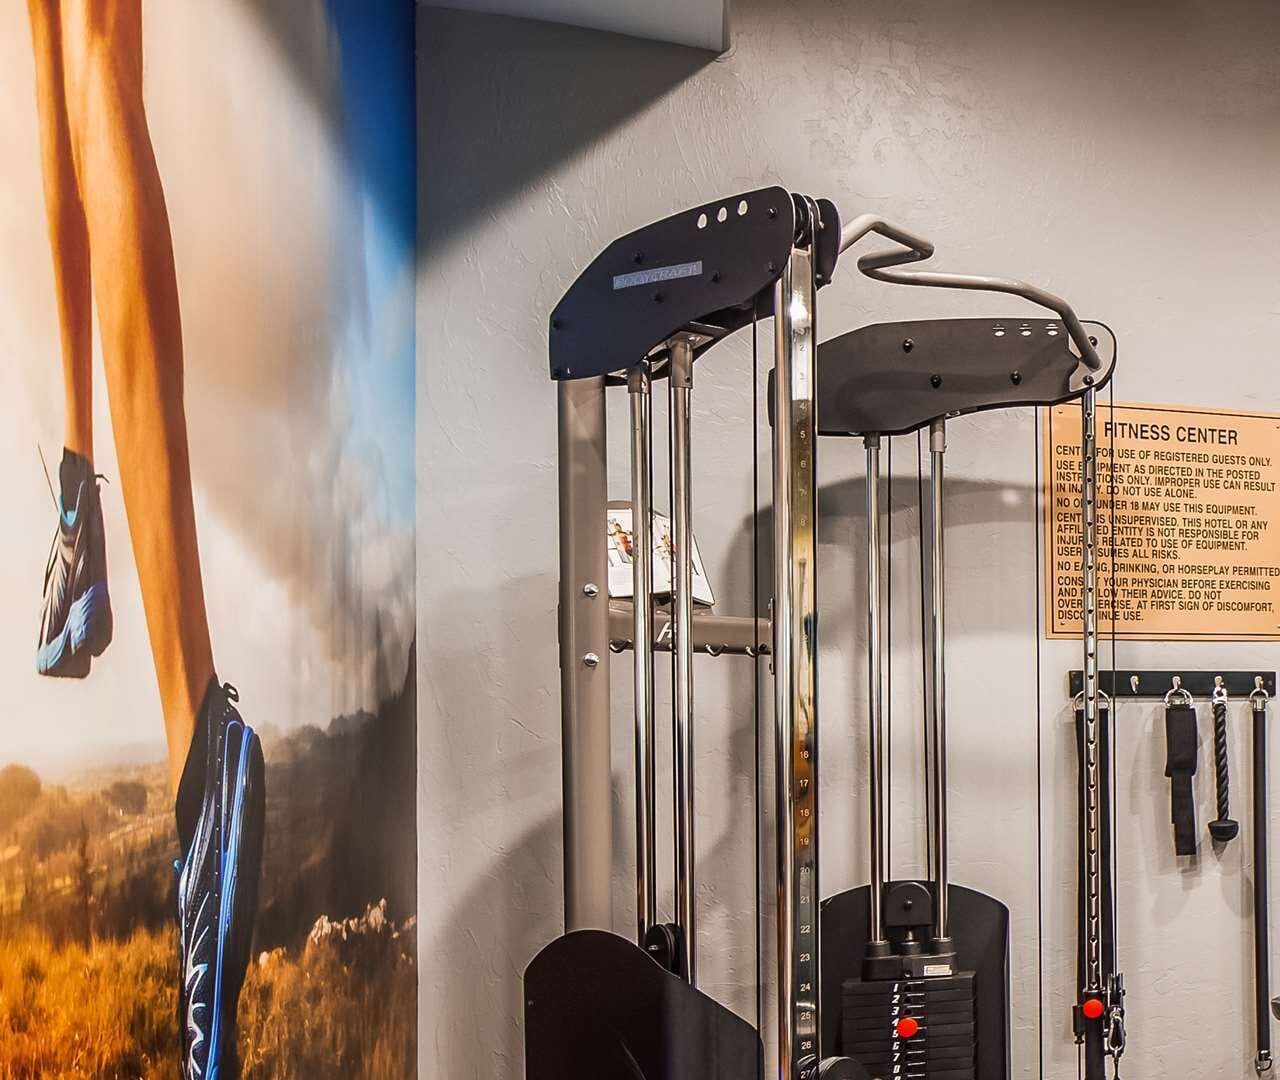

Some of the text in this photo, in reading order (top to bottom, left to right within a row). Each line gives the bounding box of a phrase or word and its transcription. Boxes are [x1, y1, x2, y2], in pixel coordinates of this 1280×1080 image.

[800, 430, 806, 439] 5
[1104, 421, 1238, 445] FITNESS CENTER
[1056, 445, 1272, 466] CENT FOR USE OF REGISTERED GUESTS ONLY.
[1056, 460, 1260, 480] USE EIPMENT AS DIRECTED IN THE POSTED
[1127, 475, 1152, 485] ONLY.
[1155, 476, 1200, 488] IMPROPER
[1203, 480, 1221, 489] USE
[1223, 480, 1241, 490] CAN
[1243, 481, 1276, 492] RESULT
[1056, 483, 1197, 499] IN INJY. DO NOT USE ALONE.
[1056, 497, 1070, 508] NO
[1097, 499, 1128, 510] UNDER
[1130, 501, 1140, 510] 18
[1141, 501, 1160, 511] MAY
[1163, 503, 1181, 512] USE
[1184, 503, 1204, 513] THIS
[1206, 504, 1258, 515] EQUIPMENT.
[1056, 512, 1268, 530] CENT IS UNSUPERVISED. THIS HOTEL OR ANY
[1057, 524, 1259, 540] AFFILED ENTITY IS NOT RESPONSIBLE FOR
[1102, 537, 1143, 548] RELATED
[1146, 538, 1158, 548] TO
[1161, 539, 1178, 549] USE
[1181, 539, 1193, 549] OF
[1196, 540, 1248, 551] EQUIPMENT.
[1057, 547, 1181, 560] USER SUMES ALL RISKS.
[1057, 561, 1071, 571] NO
[1112, 563, 1160, 574] DRINKING,
[1162, 564, 1175, 574] OR
[1178, 565, 1230, 576] HORSEPLAY
[1104, 577, 1128, 587] YOUR
[1131, 578, 1178, 588] PHYSICIAN
[1182, 579, 1217, 589] BEFORE
[1219, 580, 1271, 591] EXERCISING
[1058, 588, 1077, 597] AND
[1121, 589, 1148, 599] THEIR
[1150, 589, 1186, 600] ADVICE.
[1188, 590, 1201, 600] DO
[1204, 591, 1222, 600] NOT
[1137, 600, 1147, 610] AT
[1150, 601, 1176, 611] FIRST
[1178, 601, 1200, 611] SIGN
[1202, 601, 1214, 611] OF
[1217, 602, 1275, 613] DISCOMFORT,
[1058, 610, 1144, 621] DISCOINUE USE.
[800, 779, 809, 787] 17
[800, 925, 811, 934] 22
[800, 953, 811, 962] 23
[800, 983, 811, 991] 24
[892, 995, 900, 1003] 2
[891, 1006, 899, 1015] 3
[893, 1053, 900, 1061] 7
